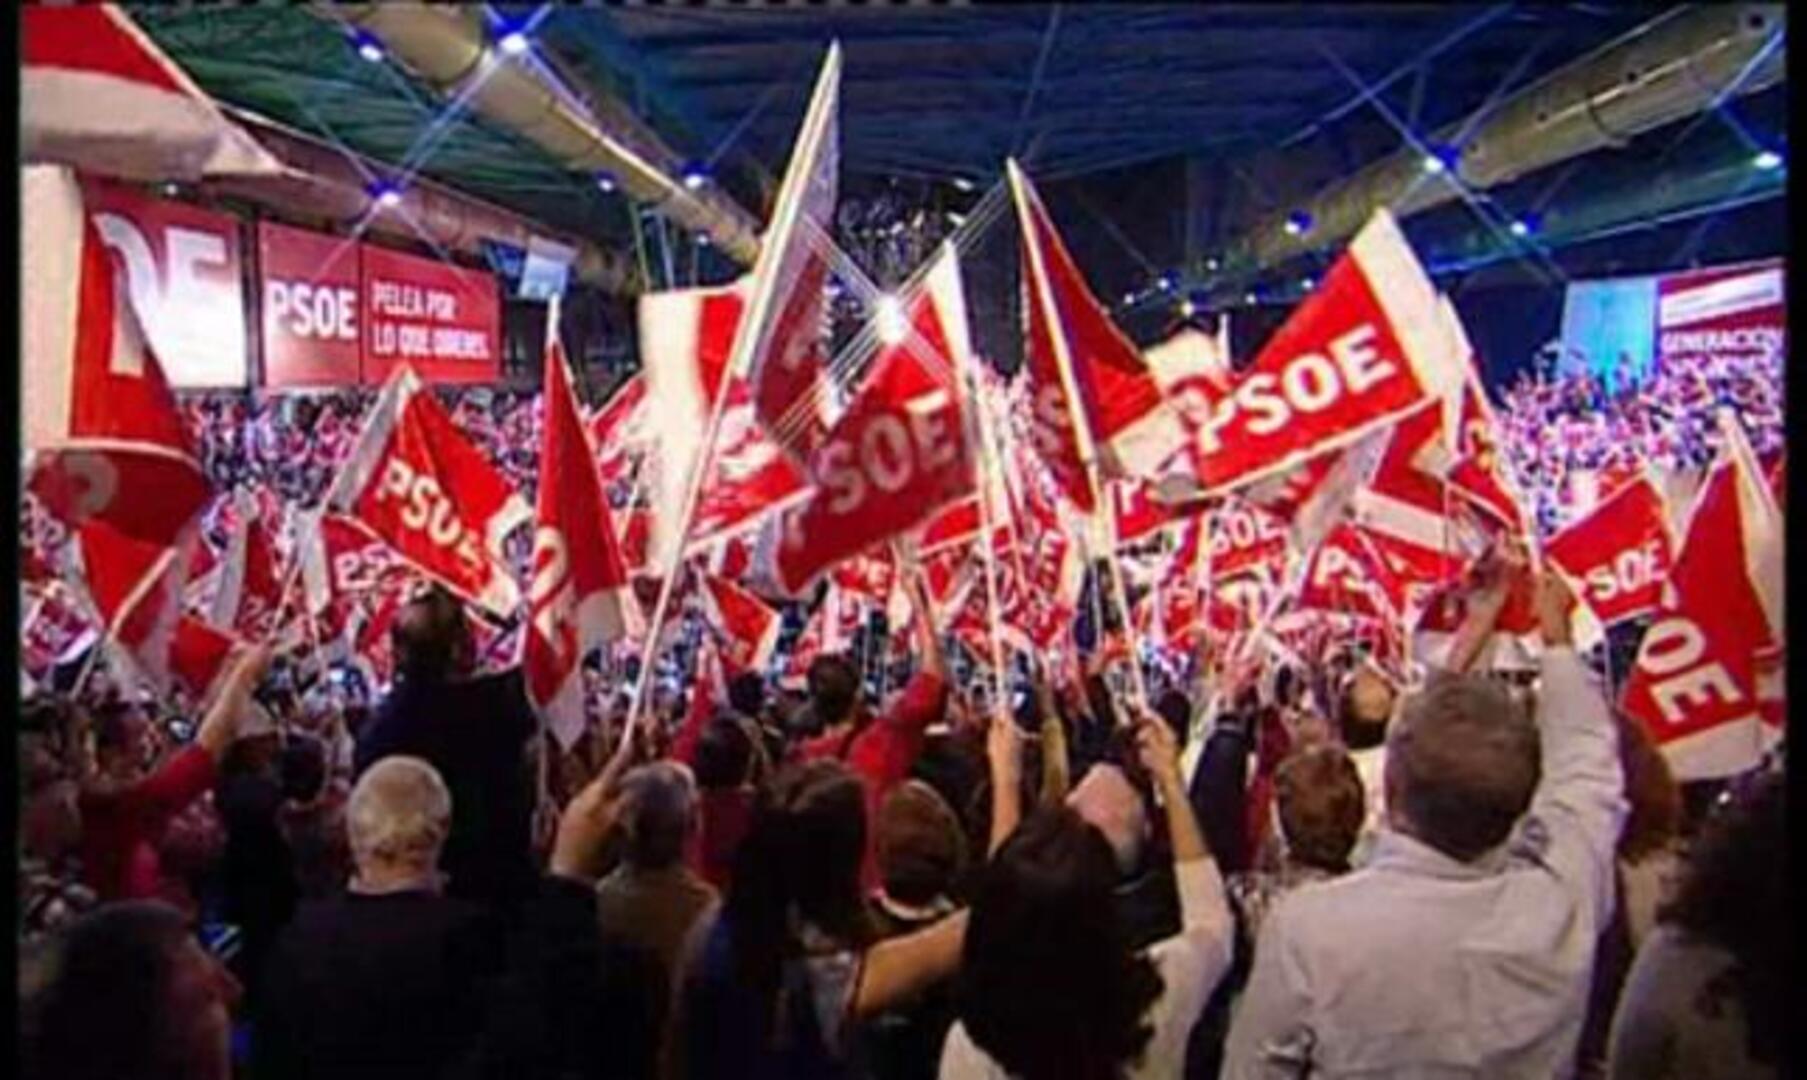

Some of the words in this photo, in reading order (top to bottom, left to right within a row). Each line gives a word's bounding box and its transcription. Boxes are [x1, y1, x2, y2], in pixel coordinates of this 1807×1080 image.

[265, 278, 358, 340] PSOE
[426, 288, 456, 320] POR
[373, 322, 396, 354] LO
[1199, 323, 1397, 454] PSOE
